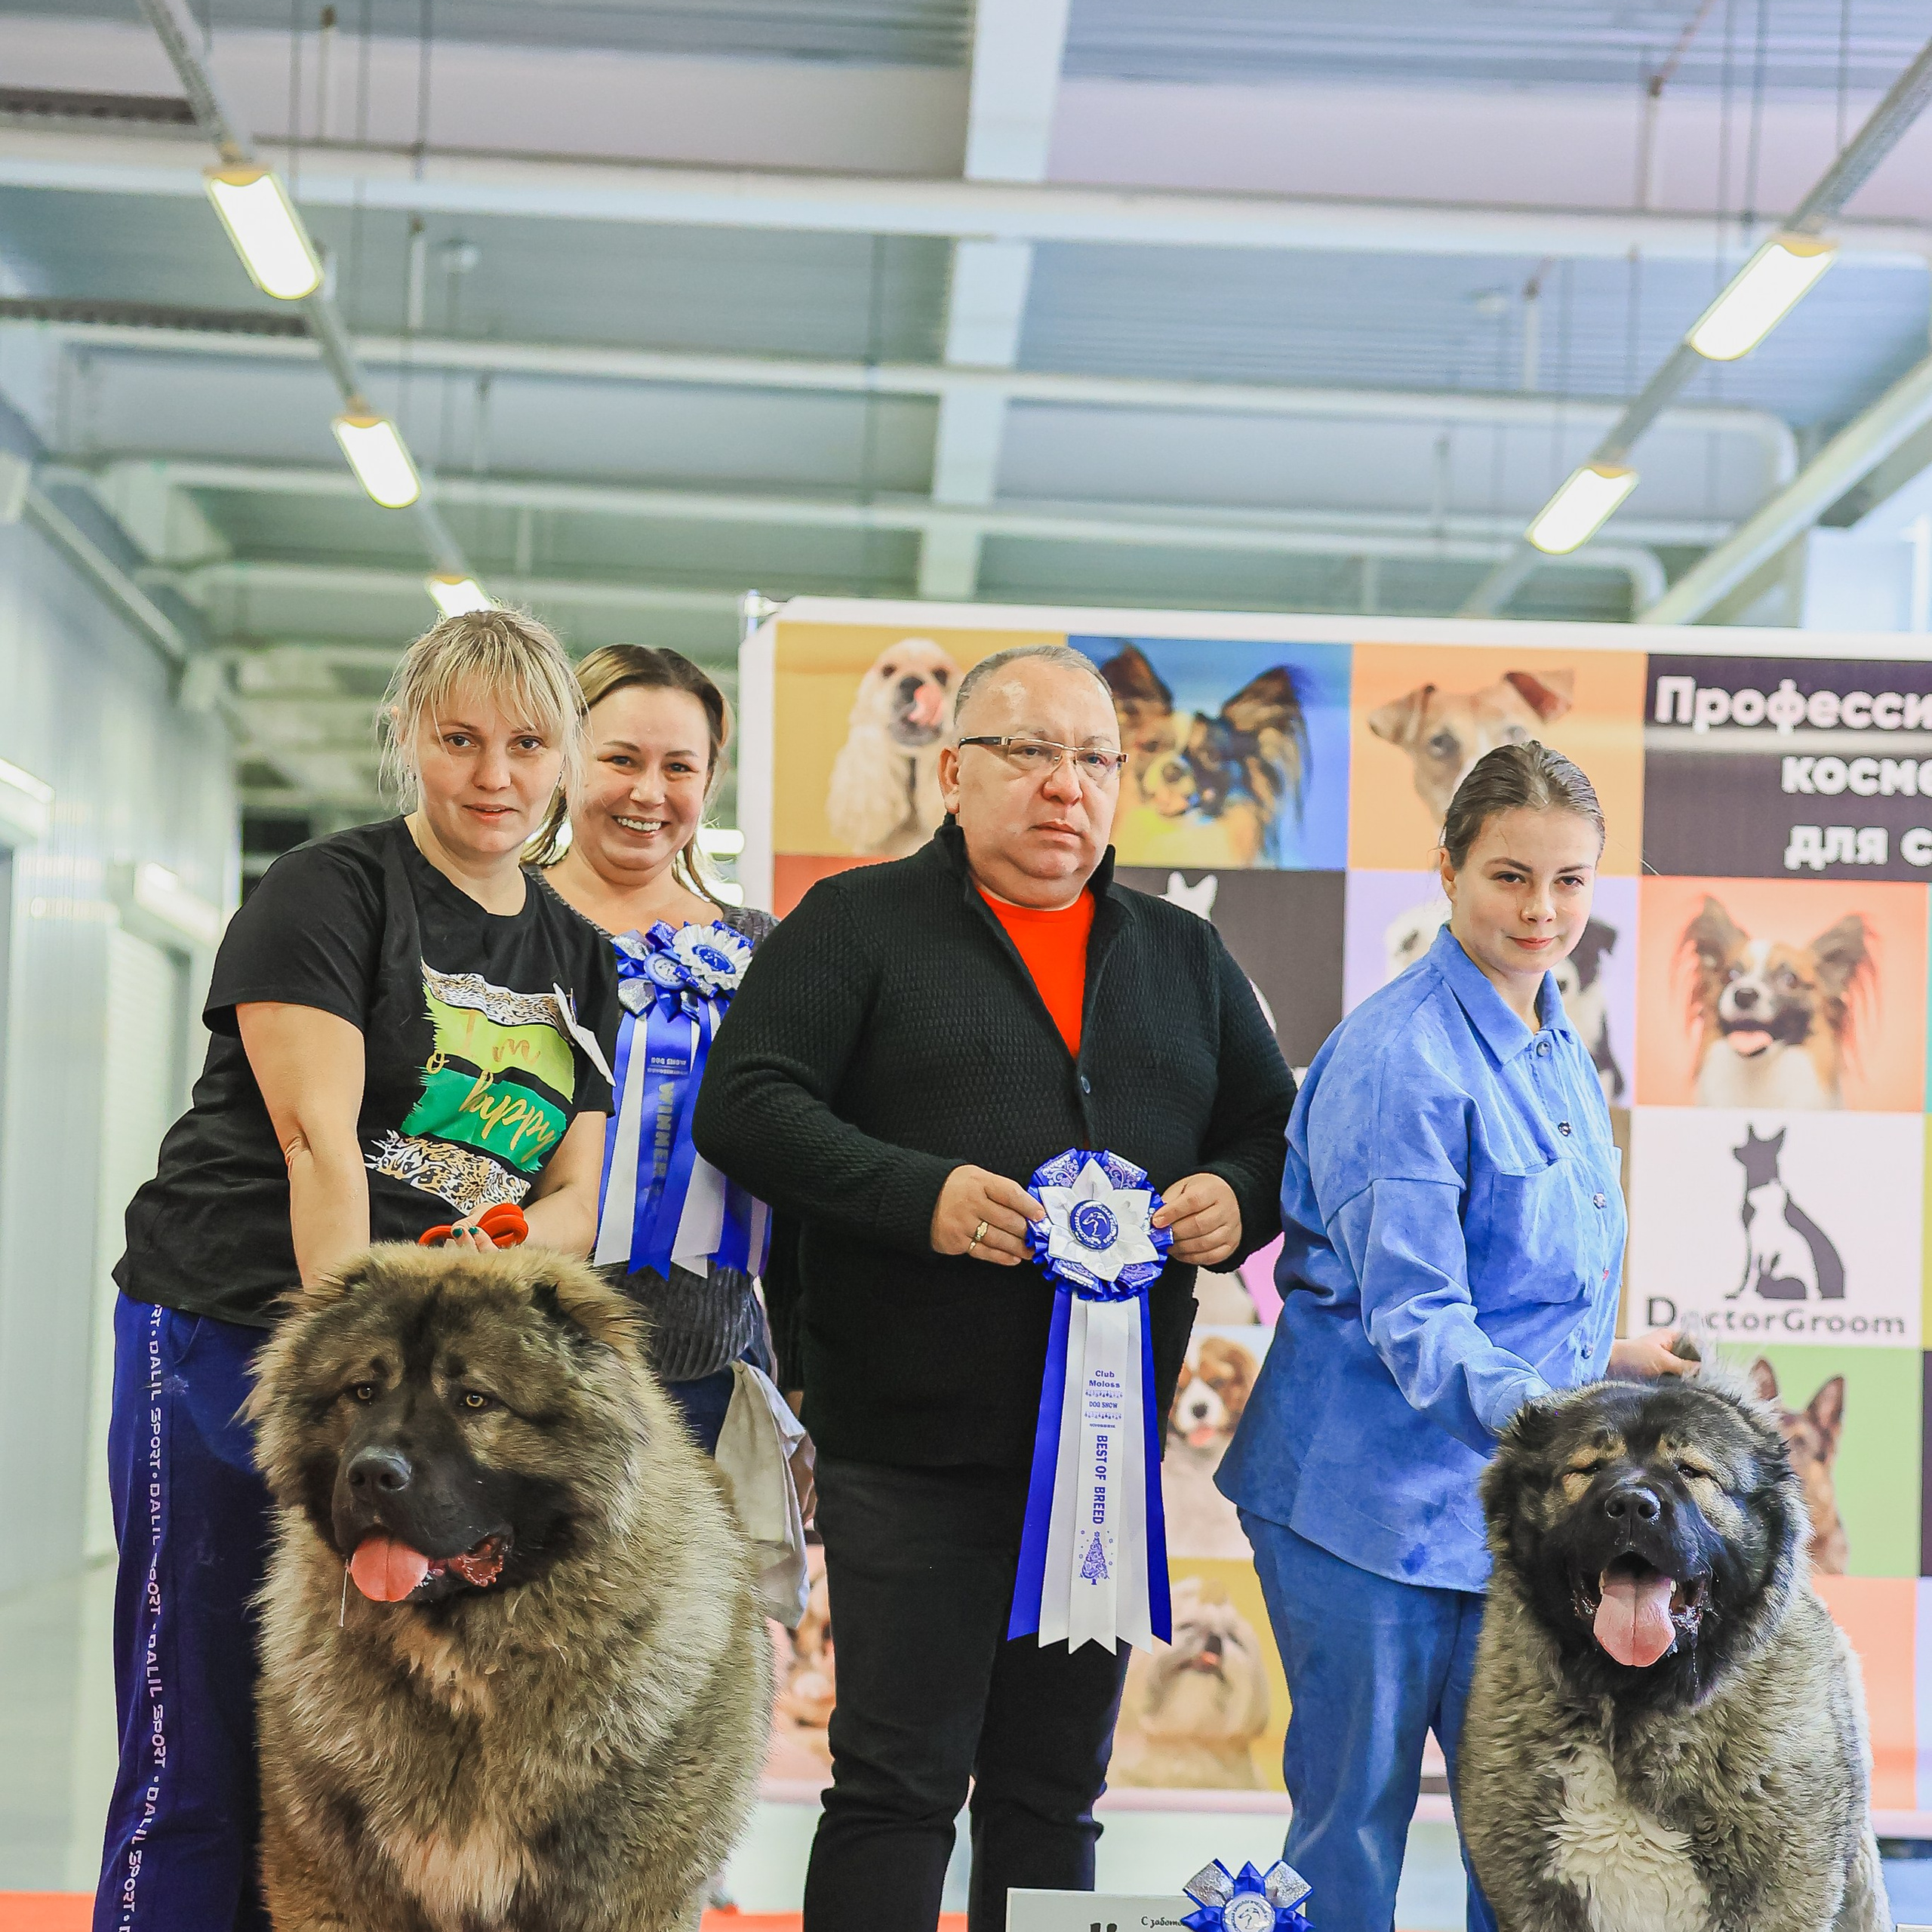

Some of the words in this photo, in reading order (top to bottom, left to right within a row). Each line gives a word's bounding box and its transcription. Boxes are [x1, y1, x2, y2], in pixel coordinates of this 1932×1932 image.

[1783, 825, 1888, 871] для
[654, 1081, 675, 1177] WINNER
[149, 1340, 162, 1401] DALIL
[1088, 1380, 1121, 1389] Moloss
[1095, 1370, 1115, 1378] Club
[149, 1407, 162, 1470] SPORT
[1096, 1435, 1108, 1463] BEST
[1095, 1466, 1107, 1481] OF
[149, 1483, 162, 1546] DALIL
[1093, 1487, 1106, 1524] BREED
[146, 1634, 162, 1698] DALIL
[152, 1704, 167, 1768] SPORT
[131, 1786, 160, 1844] DALIL
[122, 1850, 143, 1912] SPORT
[1140, 1916, 1149, 1926] С
